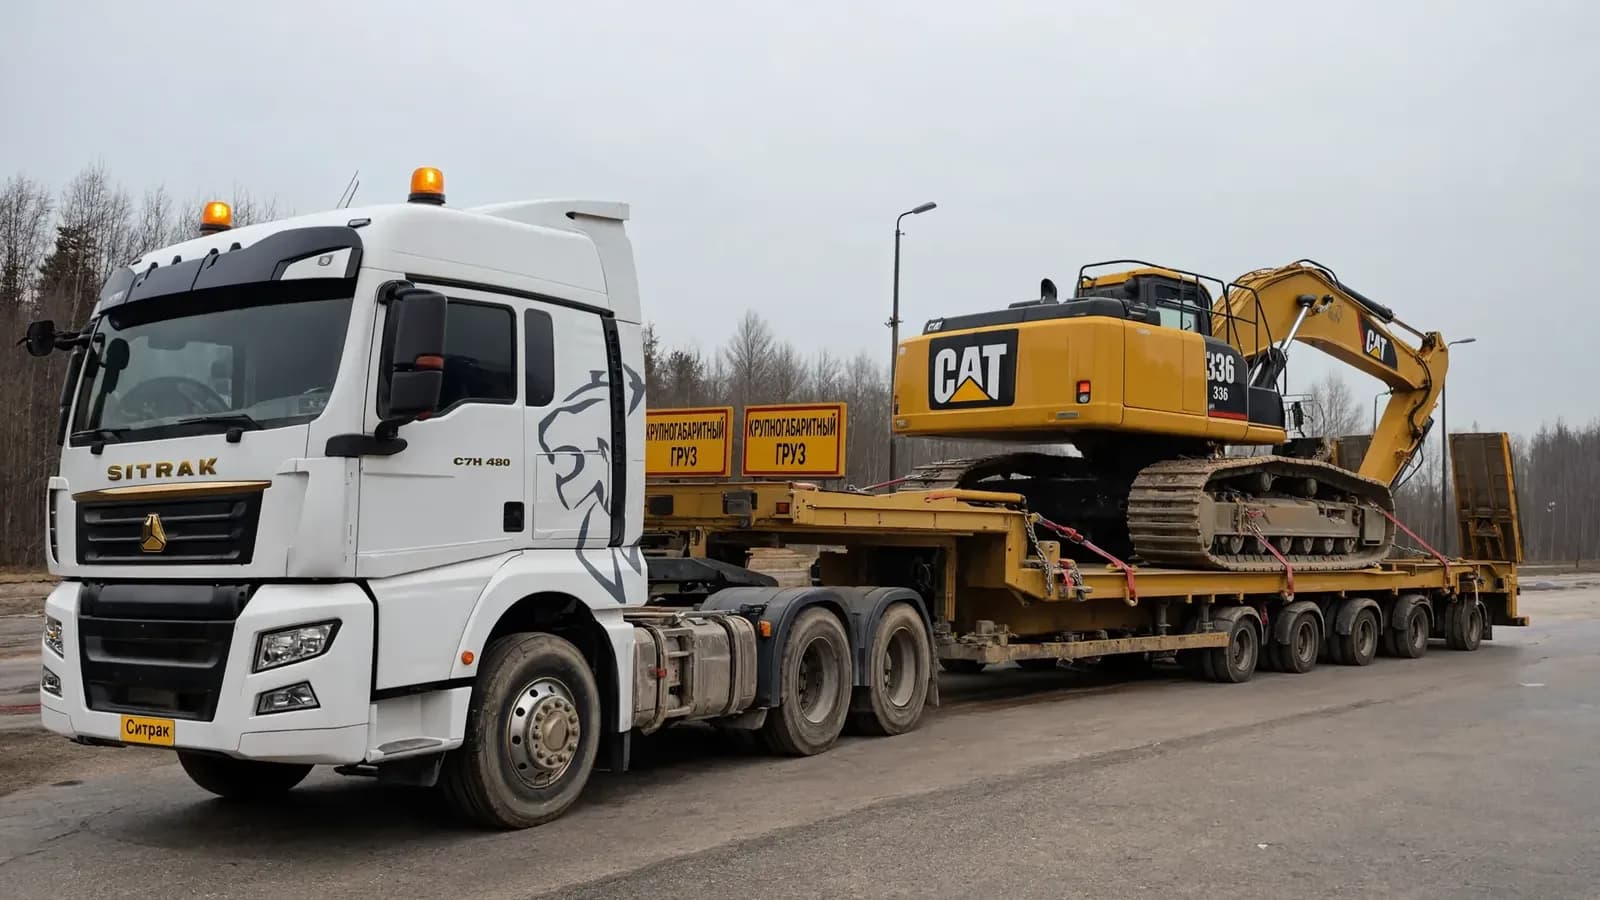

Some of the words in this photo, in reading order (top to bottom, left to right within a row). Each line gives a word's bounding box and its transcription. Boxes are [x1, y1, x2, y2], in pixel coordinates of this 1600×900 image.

[1366, 329, 1388, 361] CAT
[934, 343, 1007, 404] CAT
[1206, 351, 1235, 384] 336
[1212, 386, 1229, 401] 336
[646, 416, 724, 441] КРУПНОГАБАРИТНЫЙ
[748, 412, 836, 437] КРУПНОГАБАРИТНЫЙ
[453, 457, 482, 466] C7H
[486, 458, 511, 467] 480
[670, 446, 697, 467] ГРУЗ
[775, 442, 806, 465] ГРУЗ
[107, 457, 218, 481] SITRAK
[126, 718, 170, 741] Ситрак
